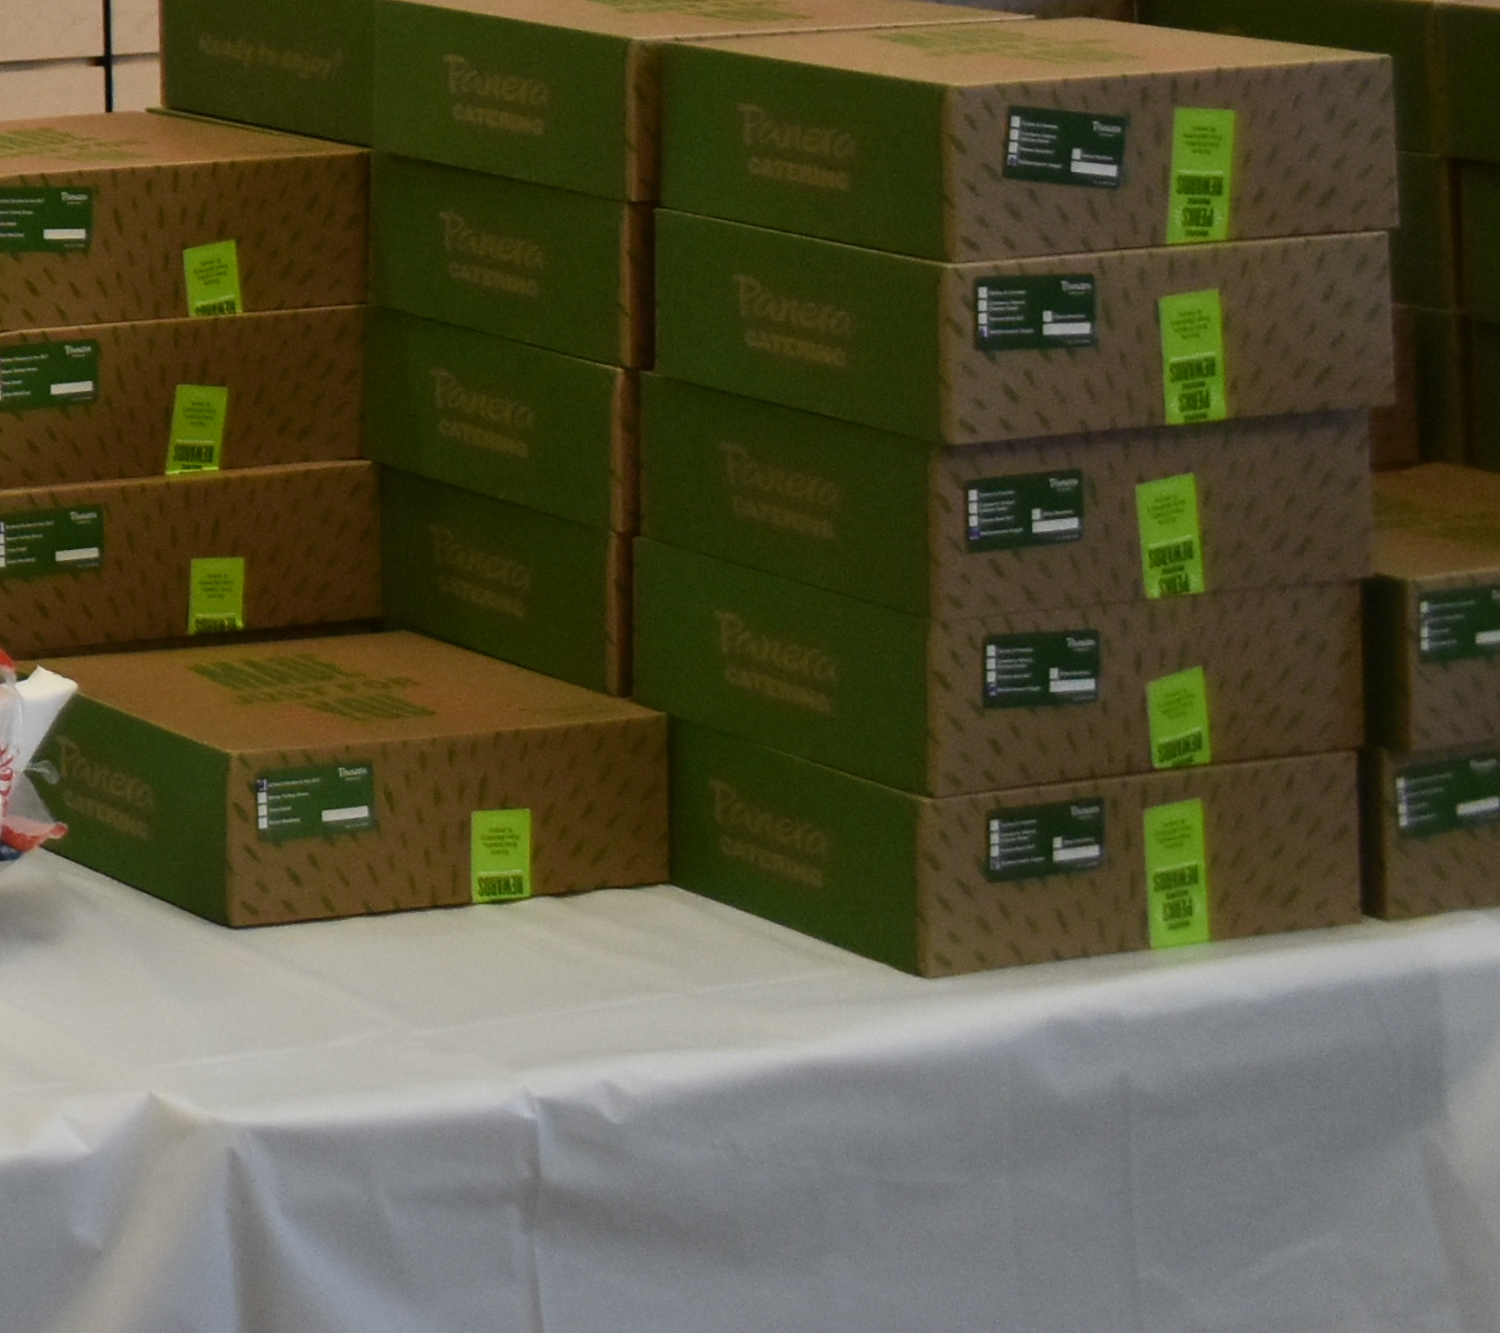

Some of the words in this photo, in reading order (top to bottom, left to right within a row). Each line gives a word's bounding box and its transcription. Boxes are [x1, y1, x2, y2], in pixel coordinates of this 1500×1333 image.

[441, 54, 550, 107] Panera
[735, 103, 856, 160] Panera
[437, 210, 546, 264] Panera
[732, 274, 854, 332] Panera
[55, 735, 155, 810] Panera
[709, 777, 831, 855] Panera
